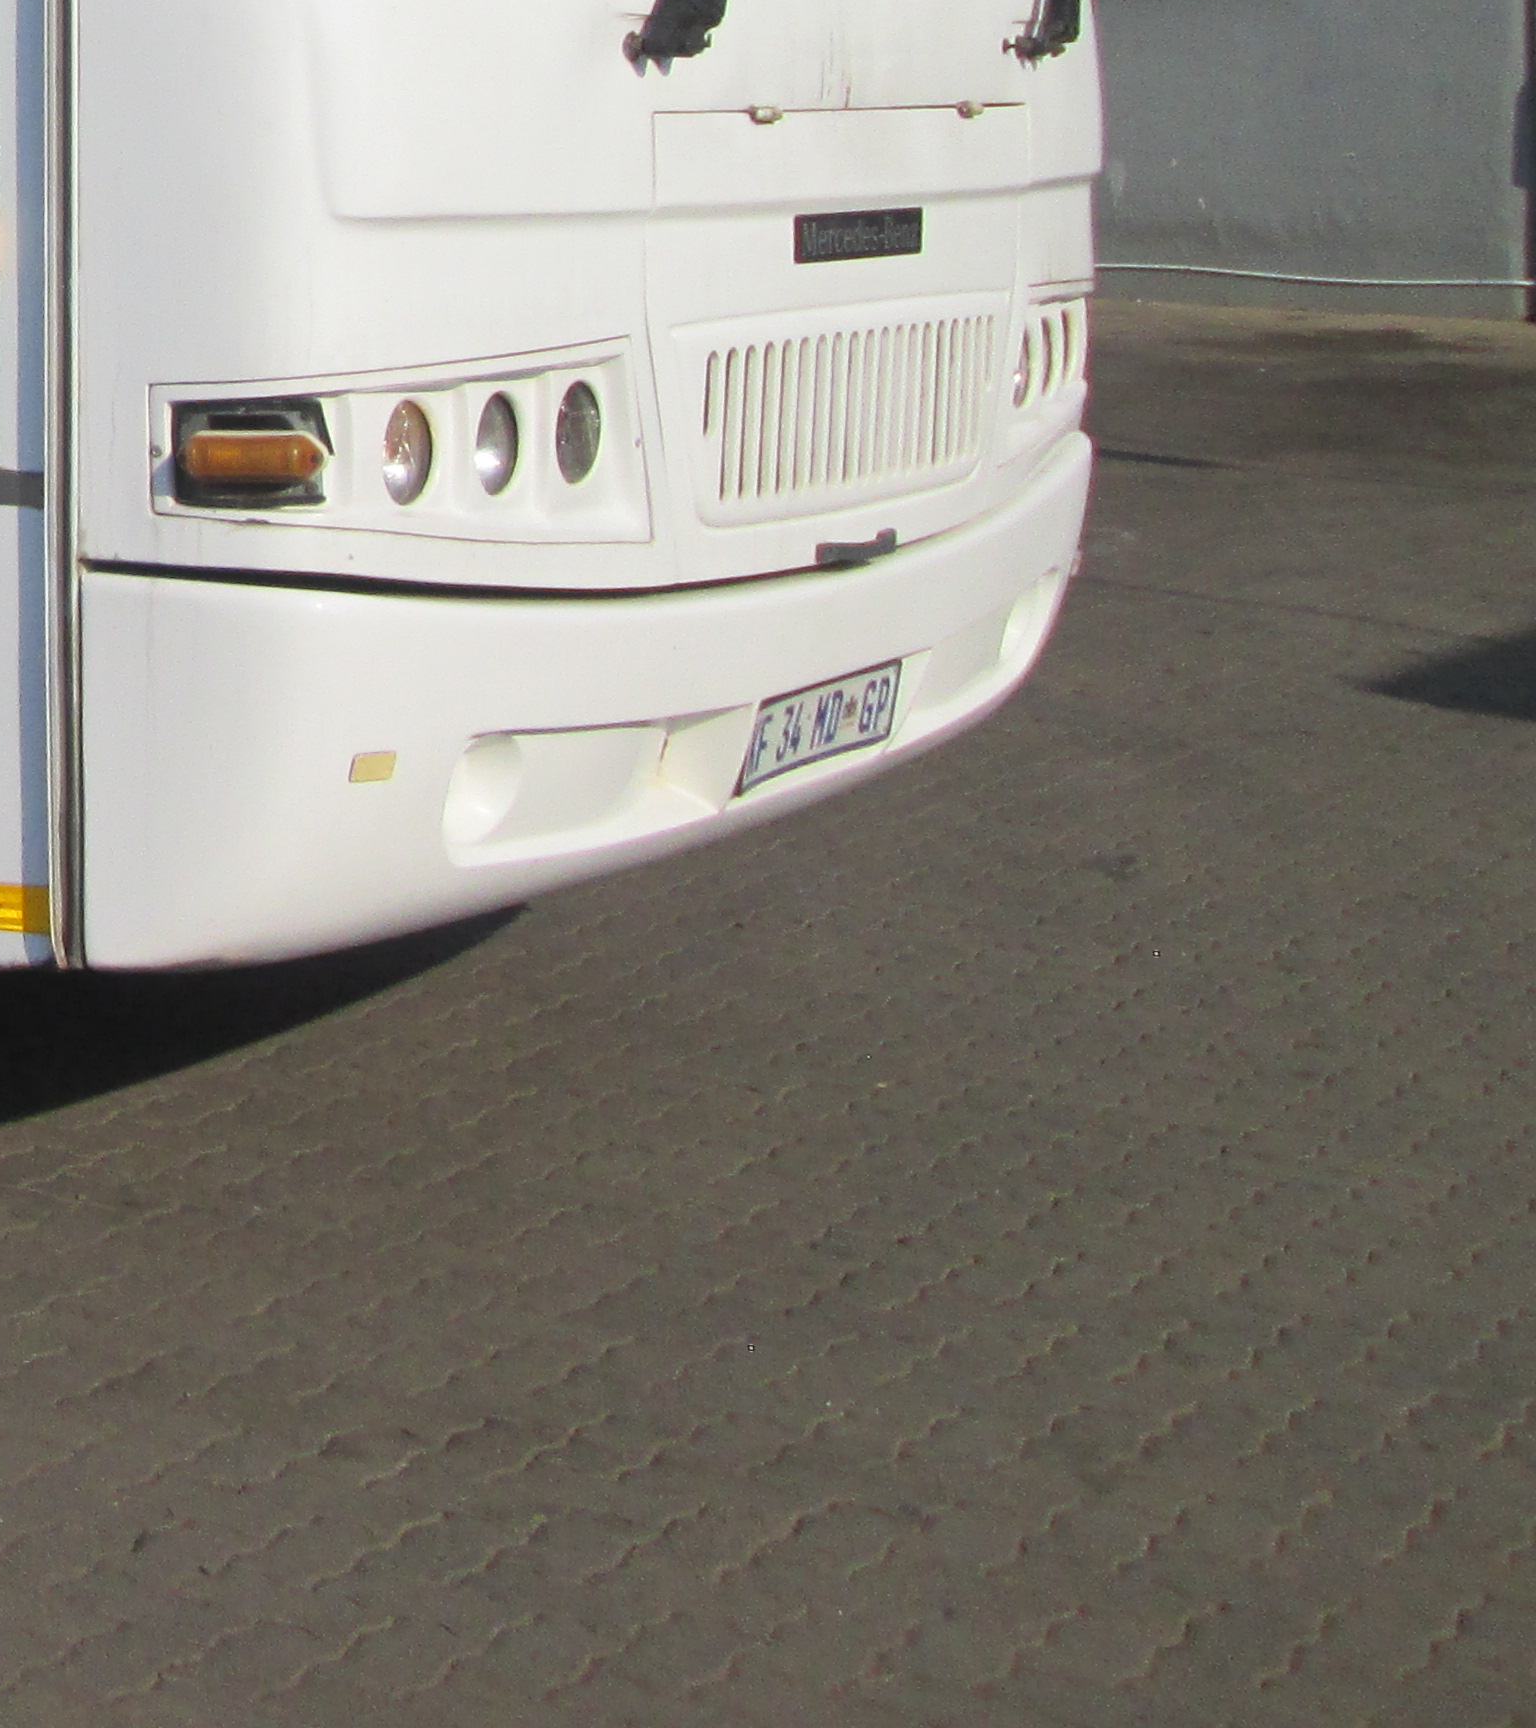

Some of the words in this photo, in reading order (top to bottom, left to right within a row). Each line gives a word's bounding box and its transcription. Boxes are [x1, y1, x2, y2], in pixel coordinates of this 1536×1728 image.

[801, 215, 920, 256] Mercedes-Benz
[775, 701, 804, 761] 34
[858, 676, 890, 733] GP
